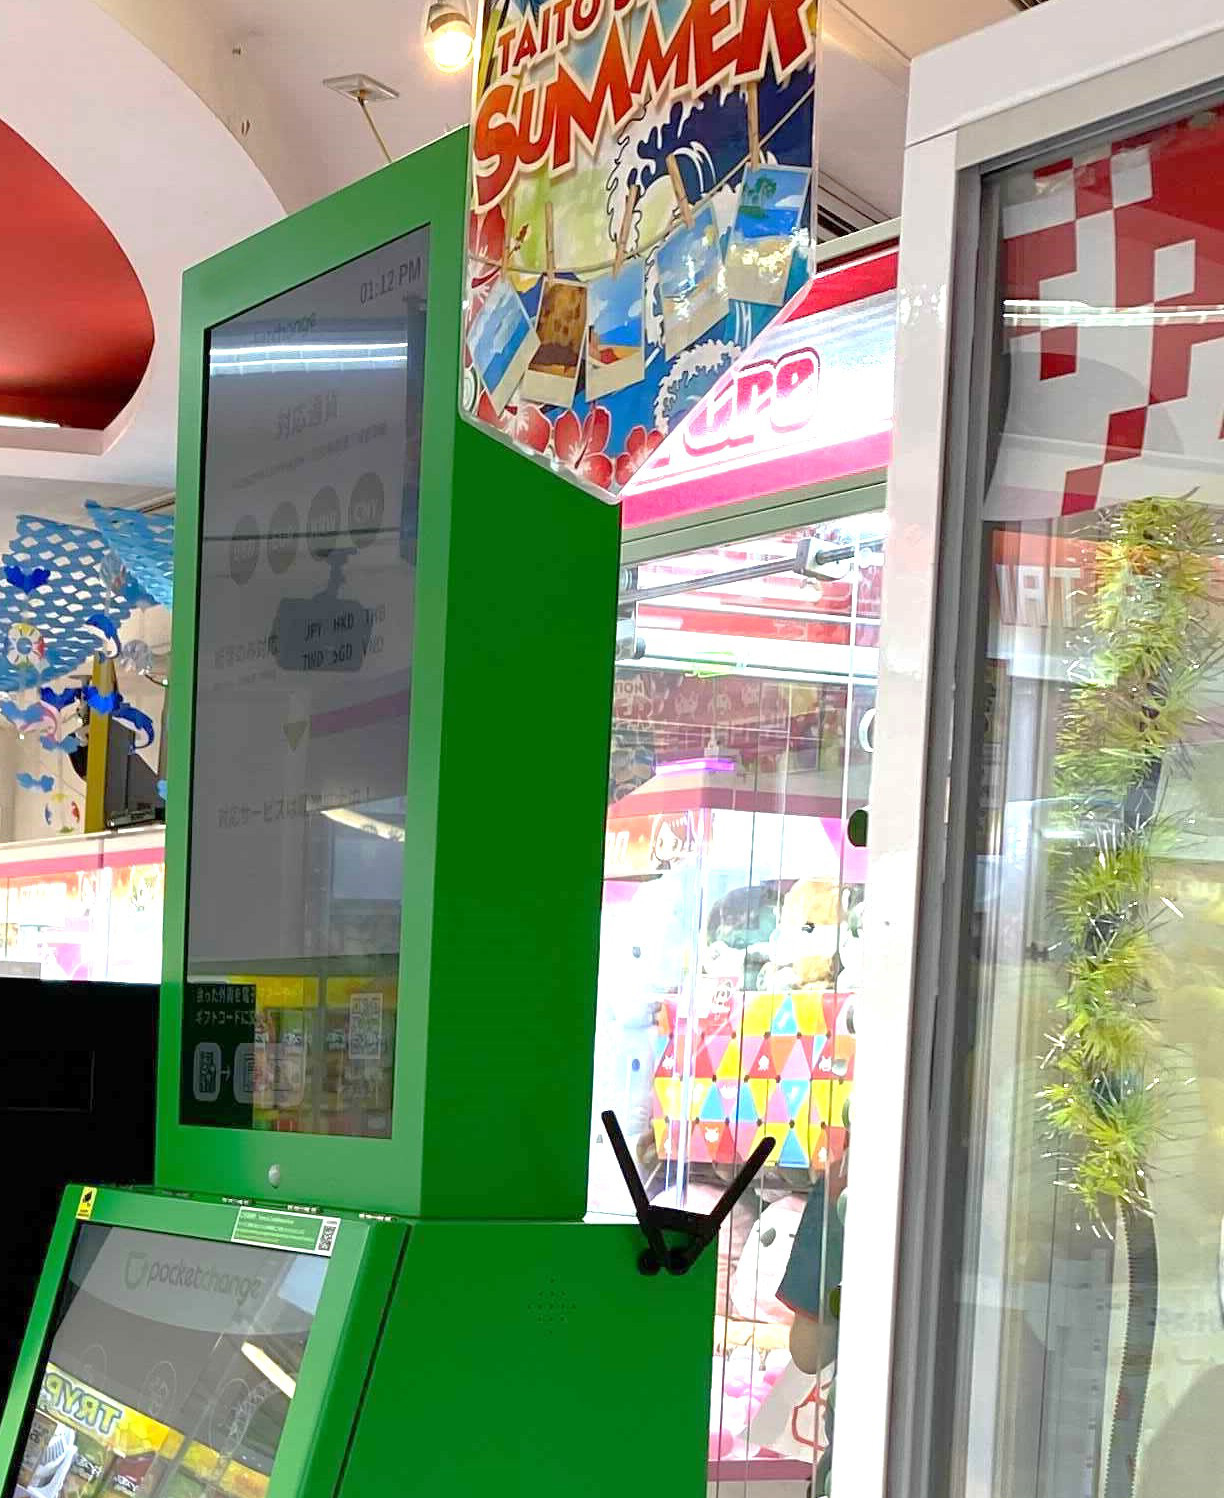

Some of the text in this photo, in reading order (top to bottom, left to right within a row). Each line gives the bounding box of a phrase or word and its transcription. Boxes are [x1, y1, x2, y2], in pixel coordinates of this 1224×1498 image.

[496, 0, 600, 77] TAITO
[474, 0, 812, 207] SUMMER
[398, 256, 422, 285] PM
